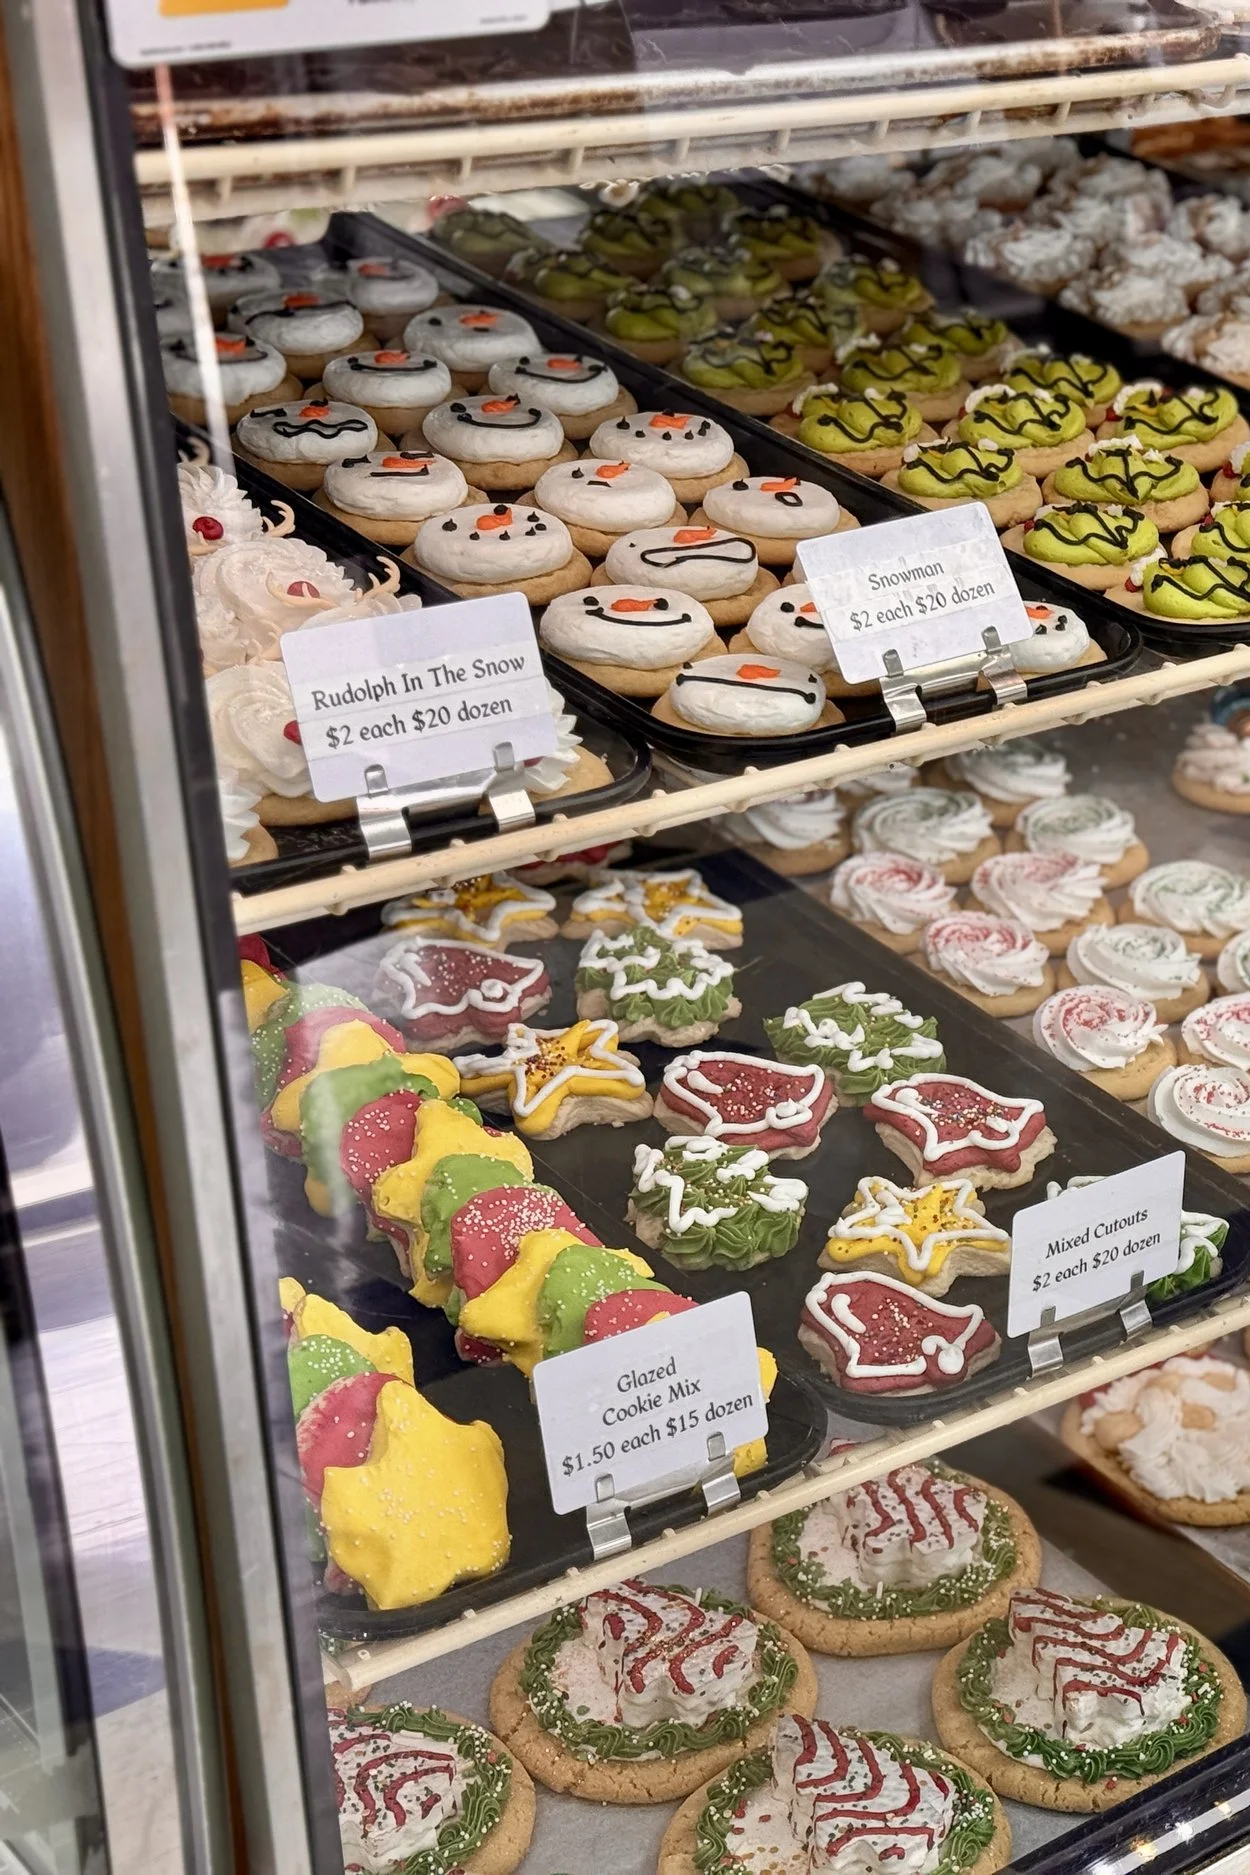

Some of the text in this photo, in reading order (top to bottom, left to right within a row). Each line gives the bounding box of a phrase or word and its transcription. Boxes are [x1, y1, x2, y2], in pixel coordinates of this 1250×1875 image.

[868, 562, 944, 590] Snowman
[850, 581, 995, 631] $2 each $20 dozen
[311, 655, 525, 711] Rudolph In The Snow
[326, 698, 513, 749] $2 each $20 dozen
[1046, 1209, 1148, 1258] Mixed Cutouts
[1032, 1233, 1161, 1292] $2 each $20 dozen
[617, 1356, 677, 1393] Glazed
[602, 1379, 701, 1426] Cookie Mix
[562, 1395, 753, 1476] $1.50 each $15 dozen
